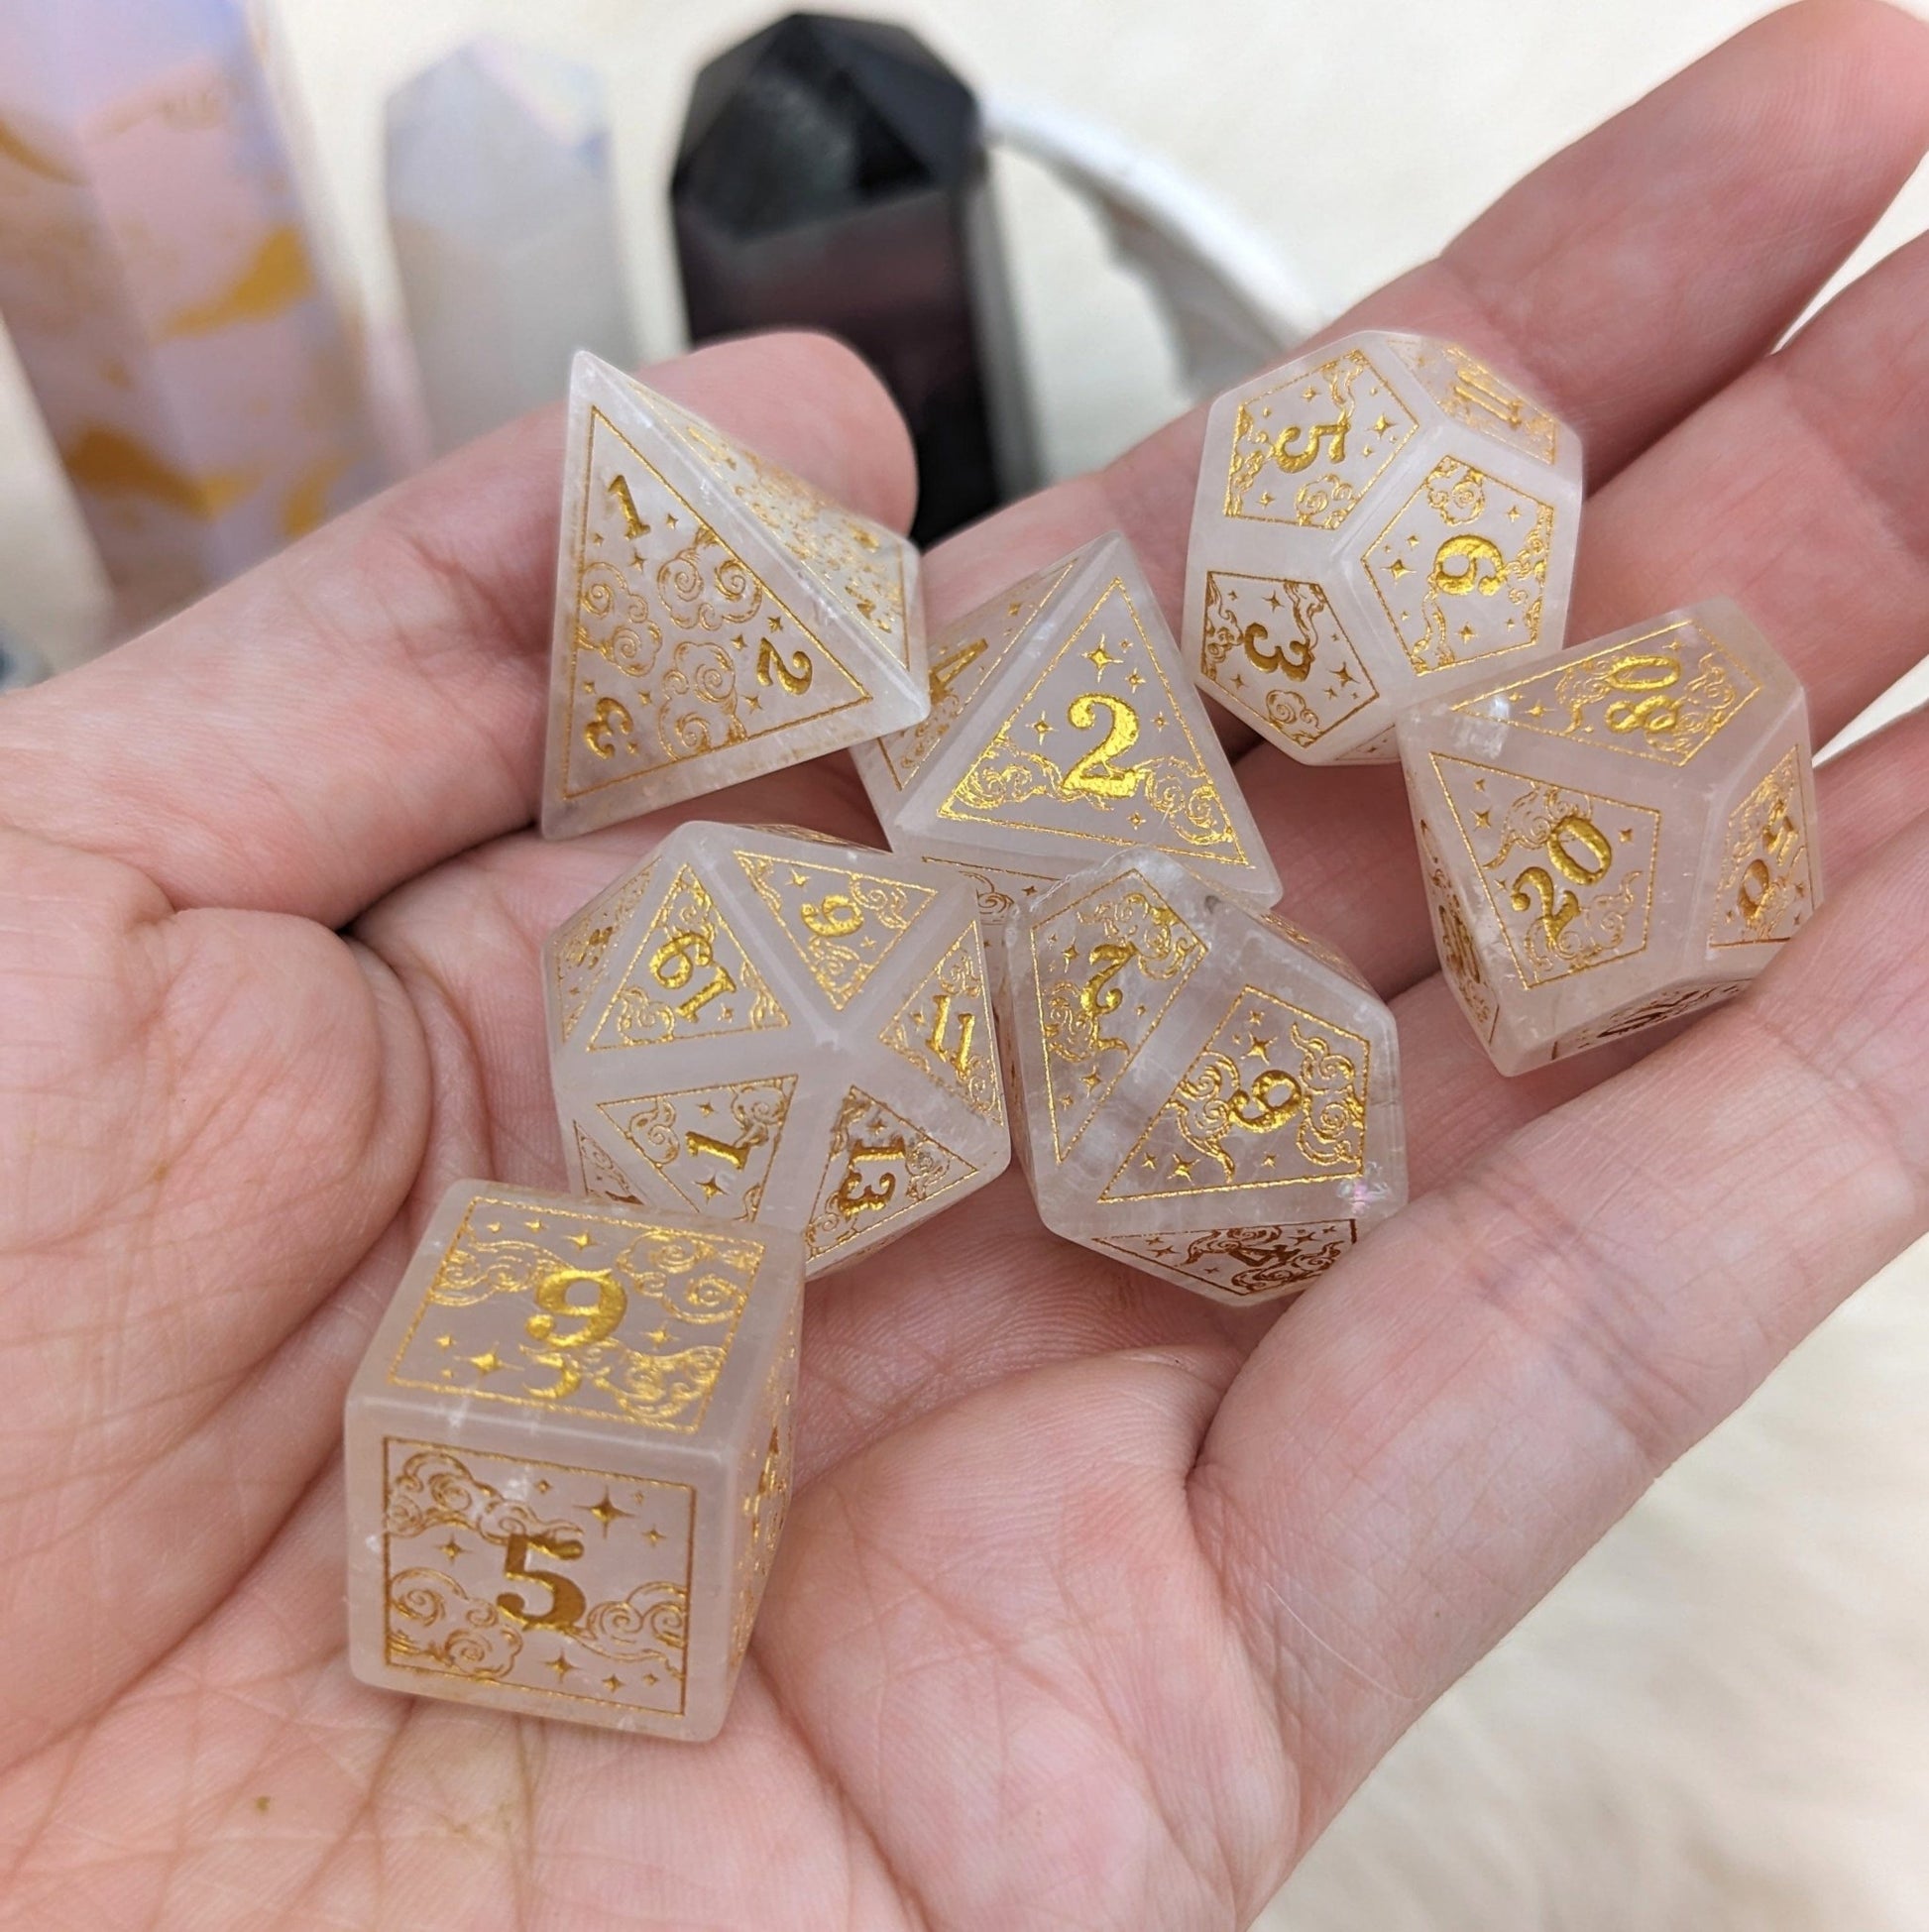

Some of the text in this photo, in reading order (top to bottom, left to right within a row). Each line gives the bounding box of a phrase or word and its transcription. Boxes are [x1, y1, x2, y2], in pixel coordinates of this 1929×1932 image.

[1275, 420, 1351, 474] 5
[608, 474, 651, 540] 1
[756, 636, 813, 695] 2
[1244, 622, 1313, 682] 3
[584, 696, 633, 760] 3
[1060, 694, 1140, 800] 2
[1511, 815, 1613, 944] 20
[1080, 943, 1136, 1014] 2
[925, 993, 976, 1077] 11
[685, 1130, 749, 1170] 1
[838, 1137, 906, 1219] 13
[497, 1534, 586, 1631] 5
